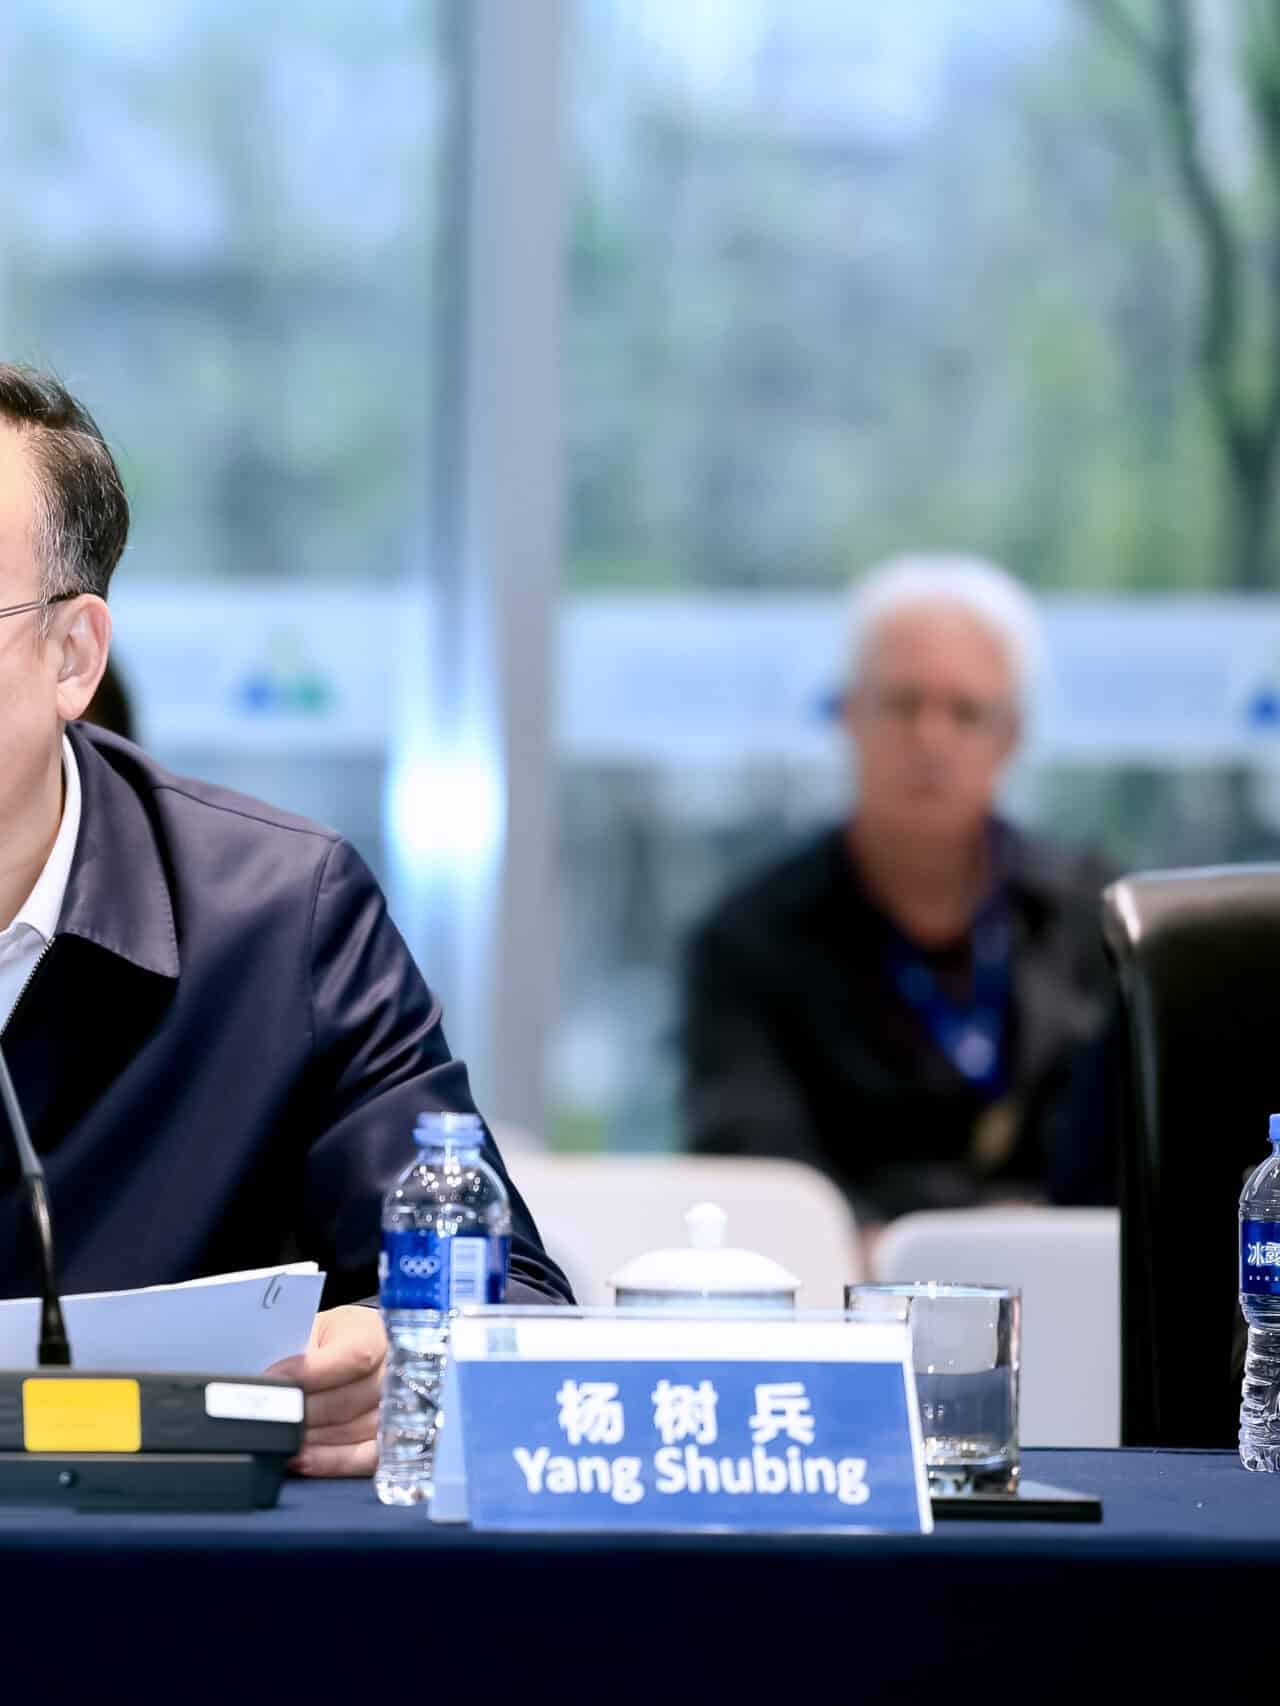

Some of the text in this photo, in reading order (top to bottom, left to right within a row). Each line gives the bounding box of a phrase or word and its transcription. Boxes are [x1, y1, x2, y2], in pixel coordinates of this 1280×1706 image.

[556, 1379, 816, 1446] 杨树兵
[513, 1444, 871, 1505] Yang Shubing
